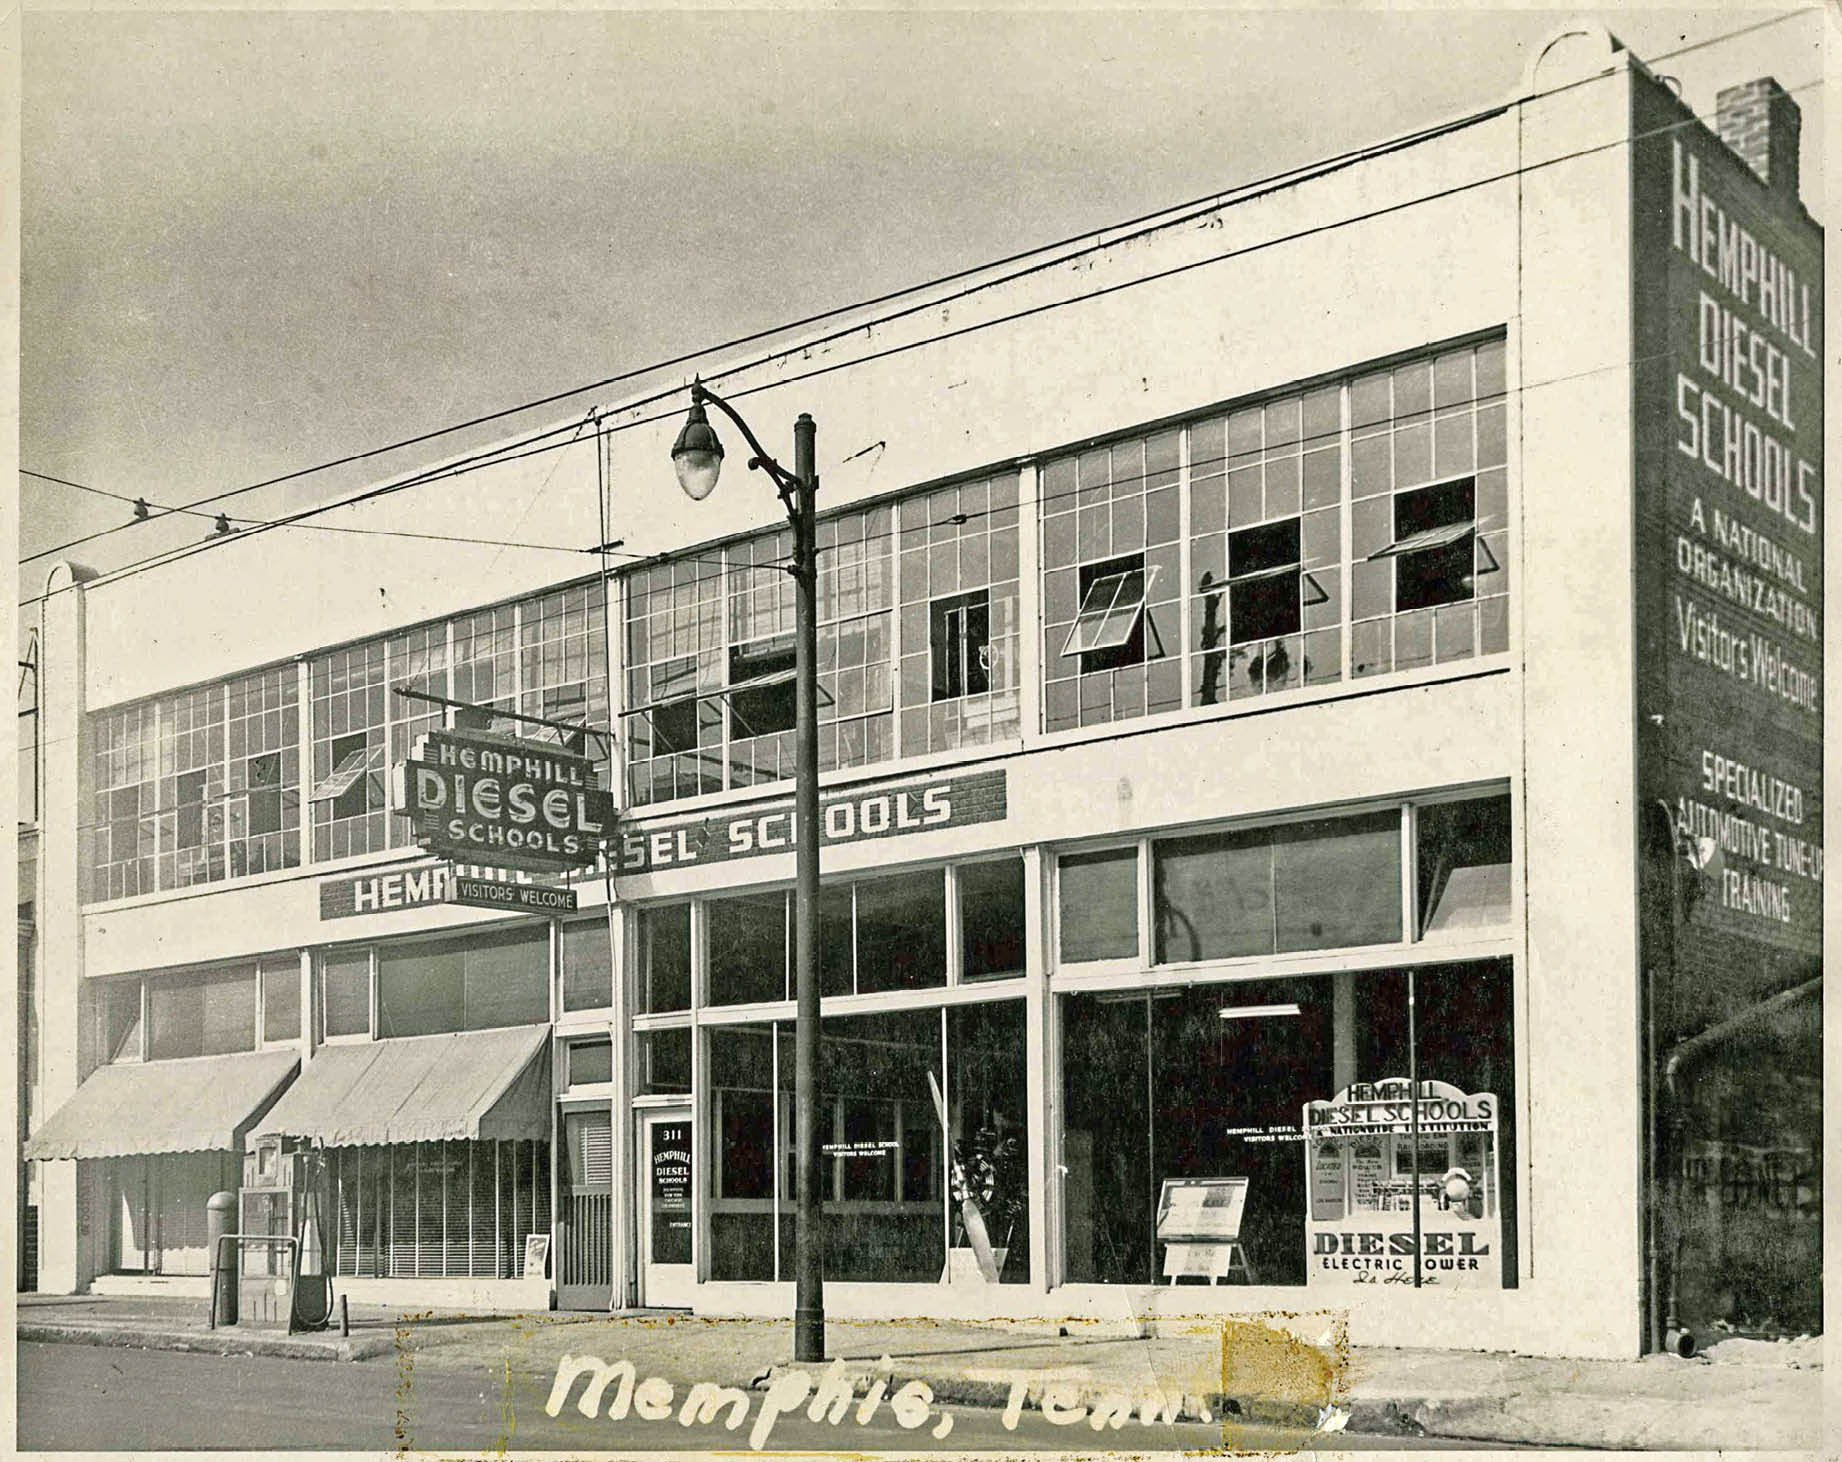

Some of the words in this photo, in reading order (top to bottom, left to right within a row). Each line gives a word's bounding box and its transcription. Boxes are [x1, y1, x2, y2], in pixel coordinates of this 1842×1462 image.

[1673, 138, 1816, 359] HEMPHILL
[1700, 290, 1796, 430] DIESEL
[1677, 373, 1816, 534] SCHOOLS
[1690, 497, 1706, 533] A
[1714, 509, 1808, 593] NATIONAL
[1677, 535, 1818, 640] ORGANIZATION
[1675, 595, 1748, 680] Visitors
[440, 744, 584, 787] HEMPHILL
[416, 768, 604, 833] DIESEL
[1703, 752, 1803, 825] SPECIALIZED
[1677, 796, 1780, 865] AUTOMOTIVE
[461, 882, 513, 901] VISITORS
[520, 889, 573, 909] WELCOME
[1723, 868, 1791, 924] TRAINING
[1308, 1103, 1379, 1127] DIESEL
[1384, 1099, 1492, 1122] SCHOOLS
[1347, 1081, 1442, 1102] HEMPHLL
[663, 1129, 682, 1141] 311
[1268, 1125, 1297, 1134] DIESEL
[1328, 1122, 1395, 1136] NATIONWIDE
[1404, 1120, 1490, 1132] ISTITUTION
[654, 1150, 691, 1165] HEMPHILL
[656, 1166, 690, 1176] DIESEL
[1314, 1232, 1490, 1256] DIESEL
[1322, 1257, 1403, 1271] ELECTRIC
[1420, 1257, 1479, 1271] OWER
